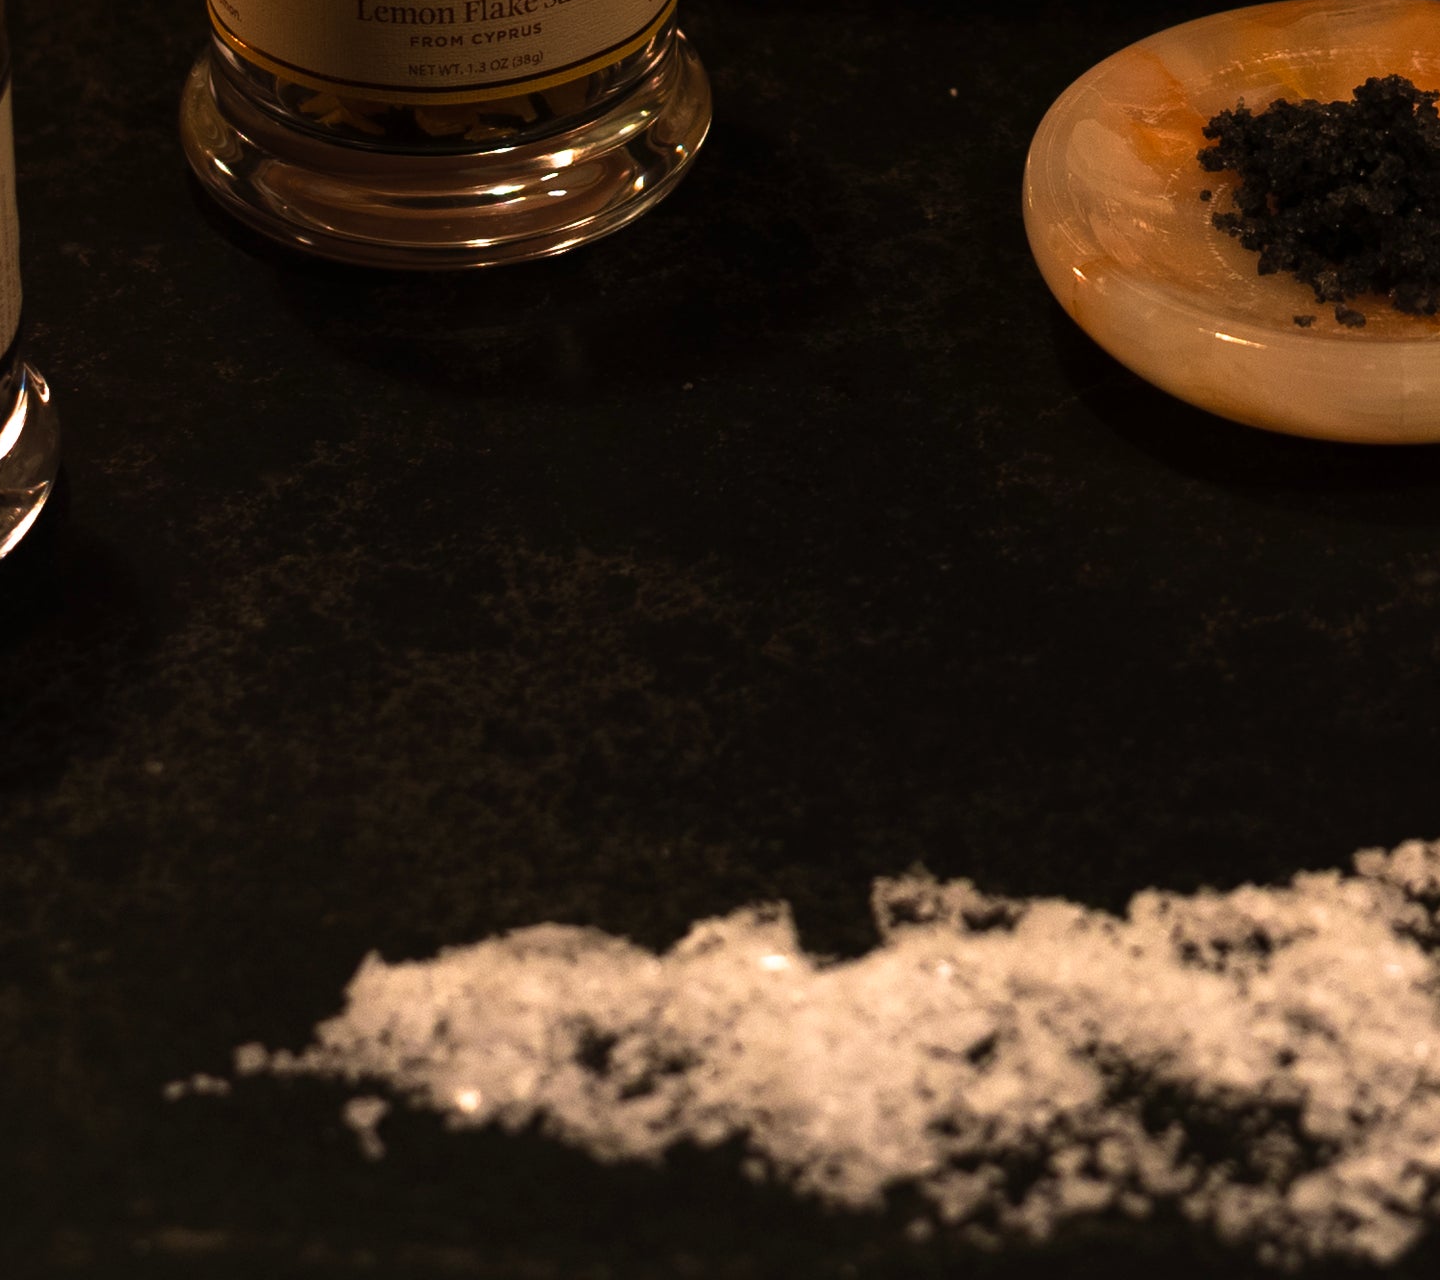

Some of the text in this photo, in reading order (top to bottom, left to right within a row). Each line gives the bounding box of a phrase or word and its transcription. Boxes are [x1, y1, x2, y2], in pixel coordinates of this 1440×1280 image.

[409, 22, 543, 49] FROM CYPRUS
[407, 63, 438, 77] NET
[467, 60, 487, 74] 1.3
[490, 58, 509, 72] OZ
